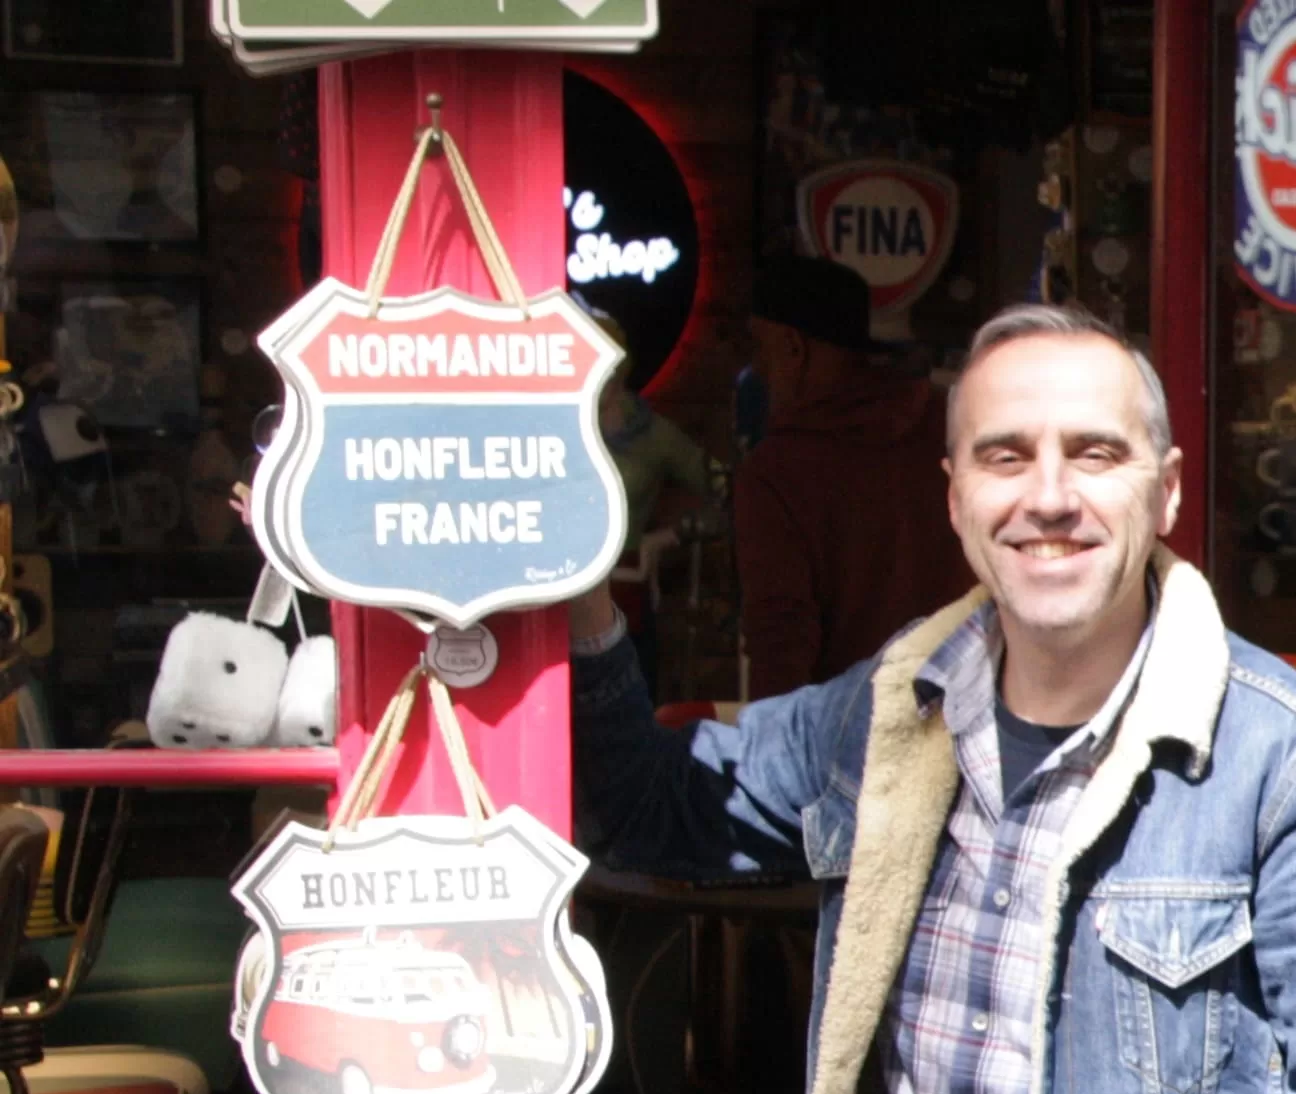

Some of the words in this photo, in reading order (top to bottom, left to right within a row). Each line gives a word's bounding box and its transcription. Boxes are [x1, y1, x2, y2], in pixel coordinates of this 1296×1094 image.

[833, 205, 926, 258] FINA
[567, 232, 681, 284] Shop
[328, 332, 575, 378] NORMANDIE
[345, 436, 566, 482] HONFLEUR
[374, 501, 543, 546] FRANCE
[302, 866, 512, 910] HONFLEUR
